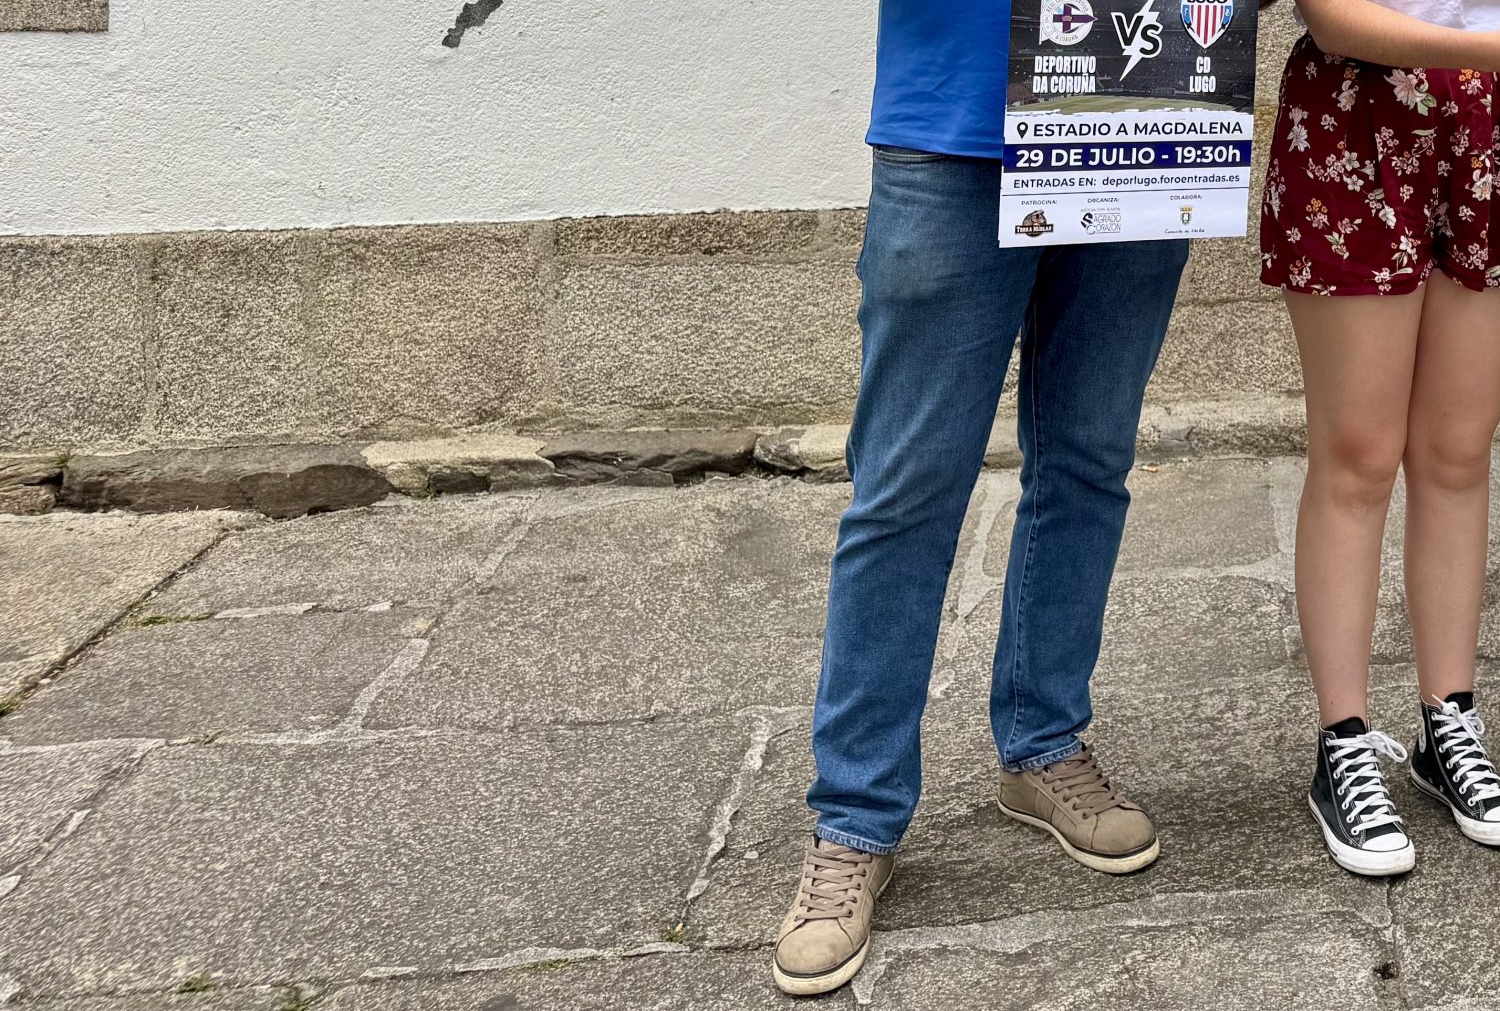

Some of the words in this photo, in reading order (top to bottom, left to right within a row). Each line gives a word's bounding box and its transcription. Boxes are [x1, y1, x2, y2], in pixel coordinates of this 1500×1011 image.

[1111, 12, 1164, 58] VS
[1034, 55, 1096, 74] DEPORTIVO
[1196, 56, 1211, 74] CD
[1032, 76, 1048, 94] DA
[1049, 73, 1096, 94] CORUÑA
[1189, 76, 1217, 94] LUGO
[1033, 123, 1112, 137] ESTADIO
[1116, 123, 1129, 136] A
[1134, 121, 1243, 136] MAGDALENA
[1016, 149, 1044, 168] 29
[1050, 148, 1084, 167] DE
[1088, 146, 1155, 166] JULIO
[1175, 145, 1241, 164] 19:30h
[1013, 177, 1075, 189] ENTRADAS
[1077, 176, 1097, 187] EN:
[1102, 173, 1240, 188] deporlugo.foroentradas.es
